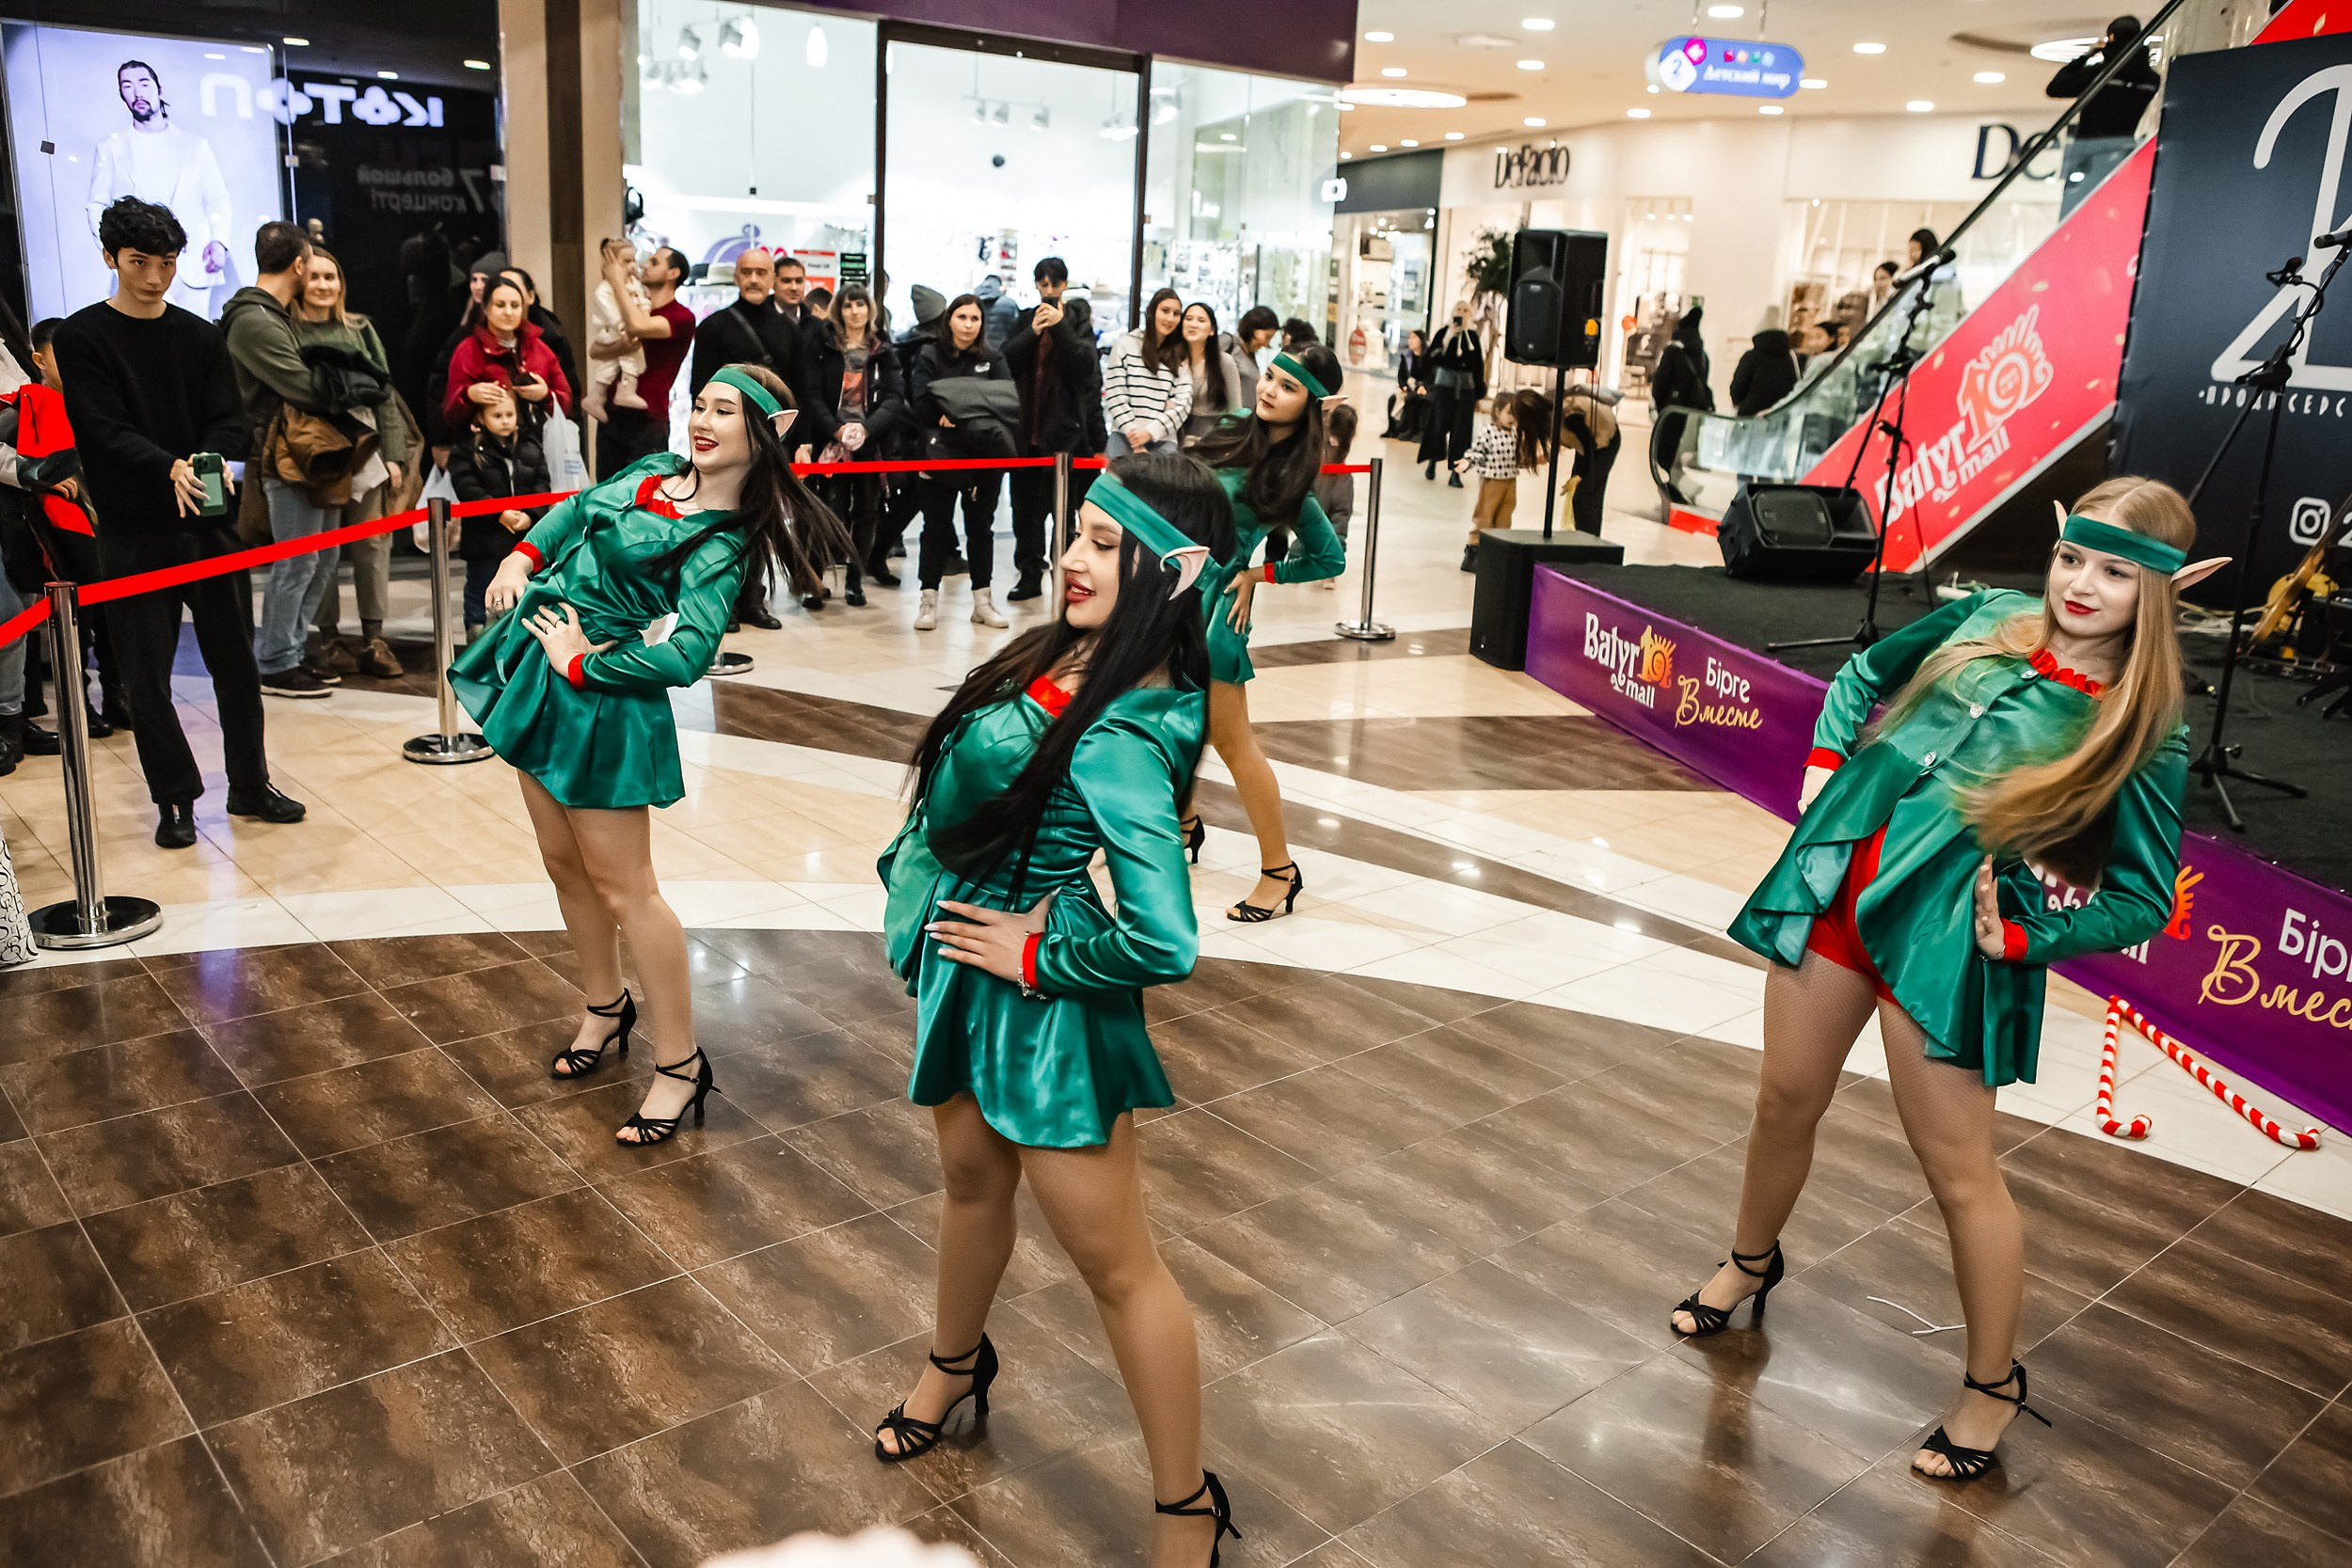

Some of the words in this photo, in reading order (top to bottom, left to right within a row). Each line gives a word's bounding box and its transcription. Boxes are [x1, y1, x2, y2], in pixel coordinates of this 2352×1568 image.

[1958, 424, 2011, 486] mall
[1583, 611, 1641, 693] Batyr
[1706, 657, 1751, 704] Бірге
[1625, 674, 1655, 709] mall
[1675, 674, 1763, 730] Вместе
[2278, 908, 2352, 983] Бір
[2198, 924, 2352, 1031] Вмес
